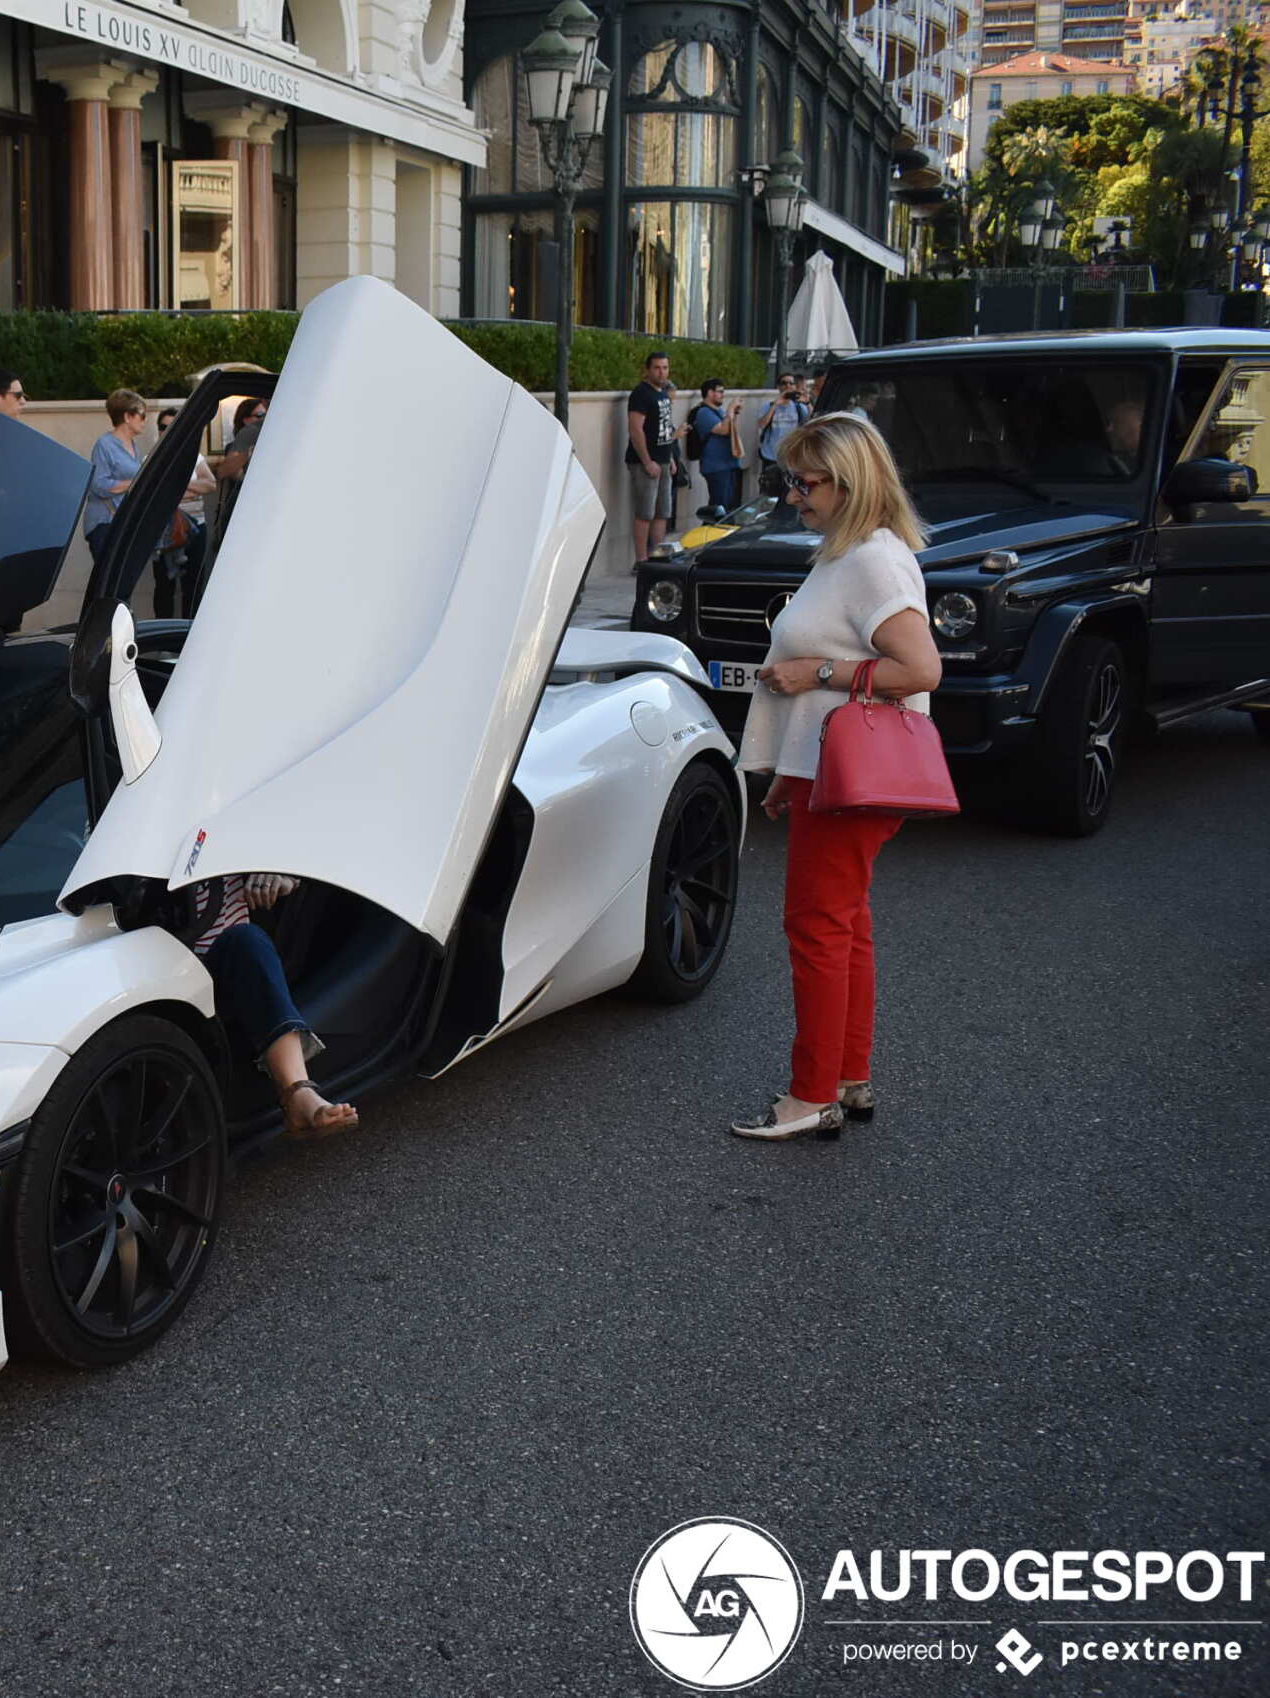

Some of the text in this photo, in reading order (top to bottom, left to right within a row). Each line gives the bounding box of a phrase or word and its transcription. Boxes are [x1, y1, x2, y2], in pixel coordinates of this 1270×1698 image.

[65, 2, 87, 32] LE
[97, 12, 151, 52] LOUIS
[160, 32, 180, 61] XV
[184, 828, 207, 877] 720S
